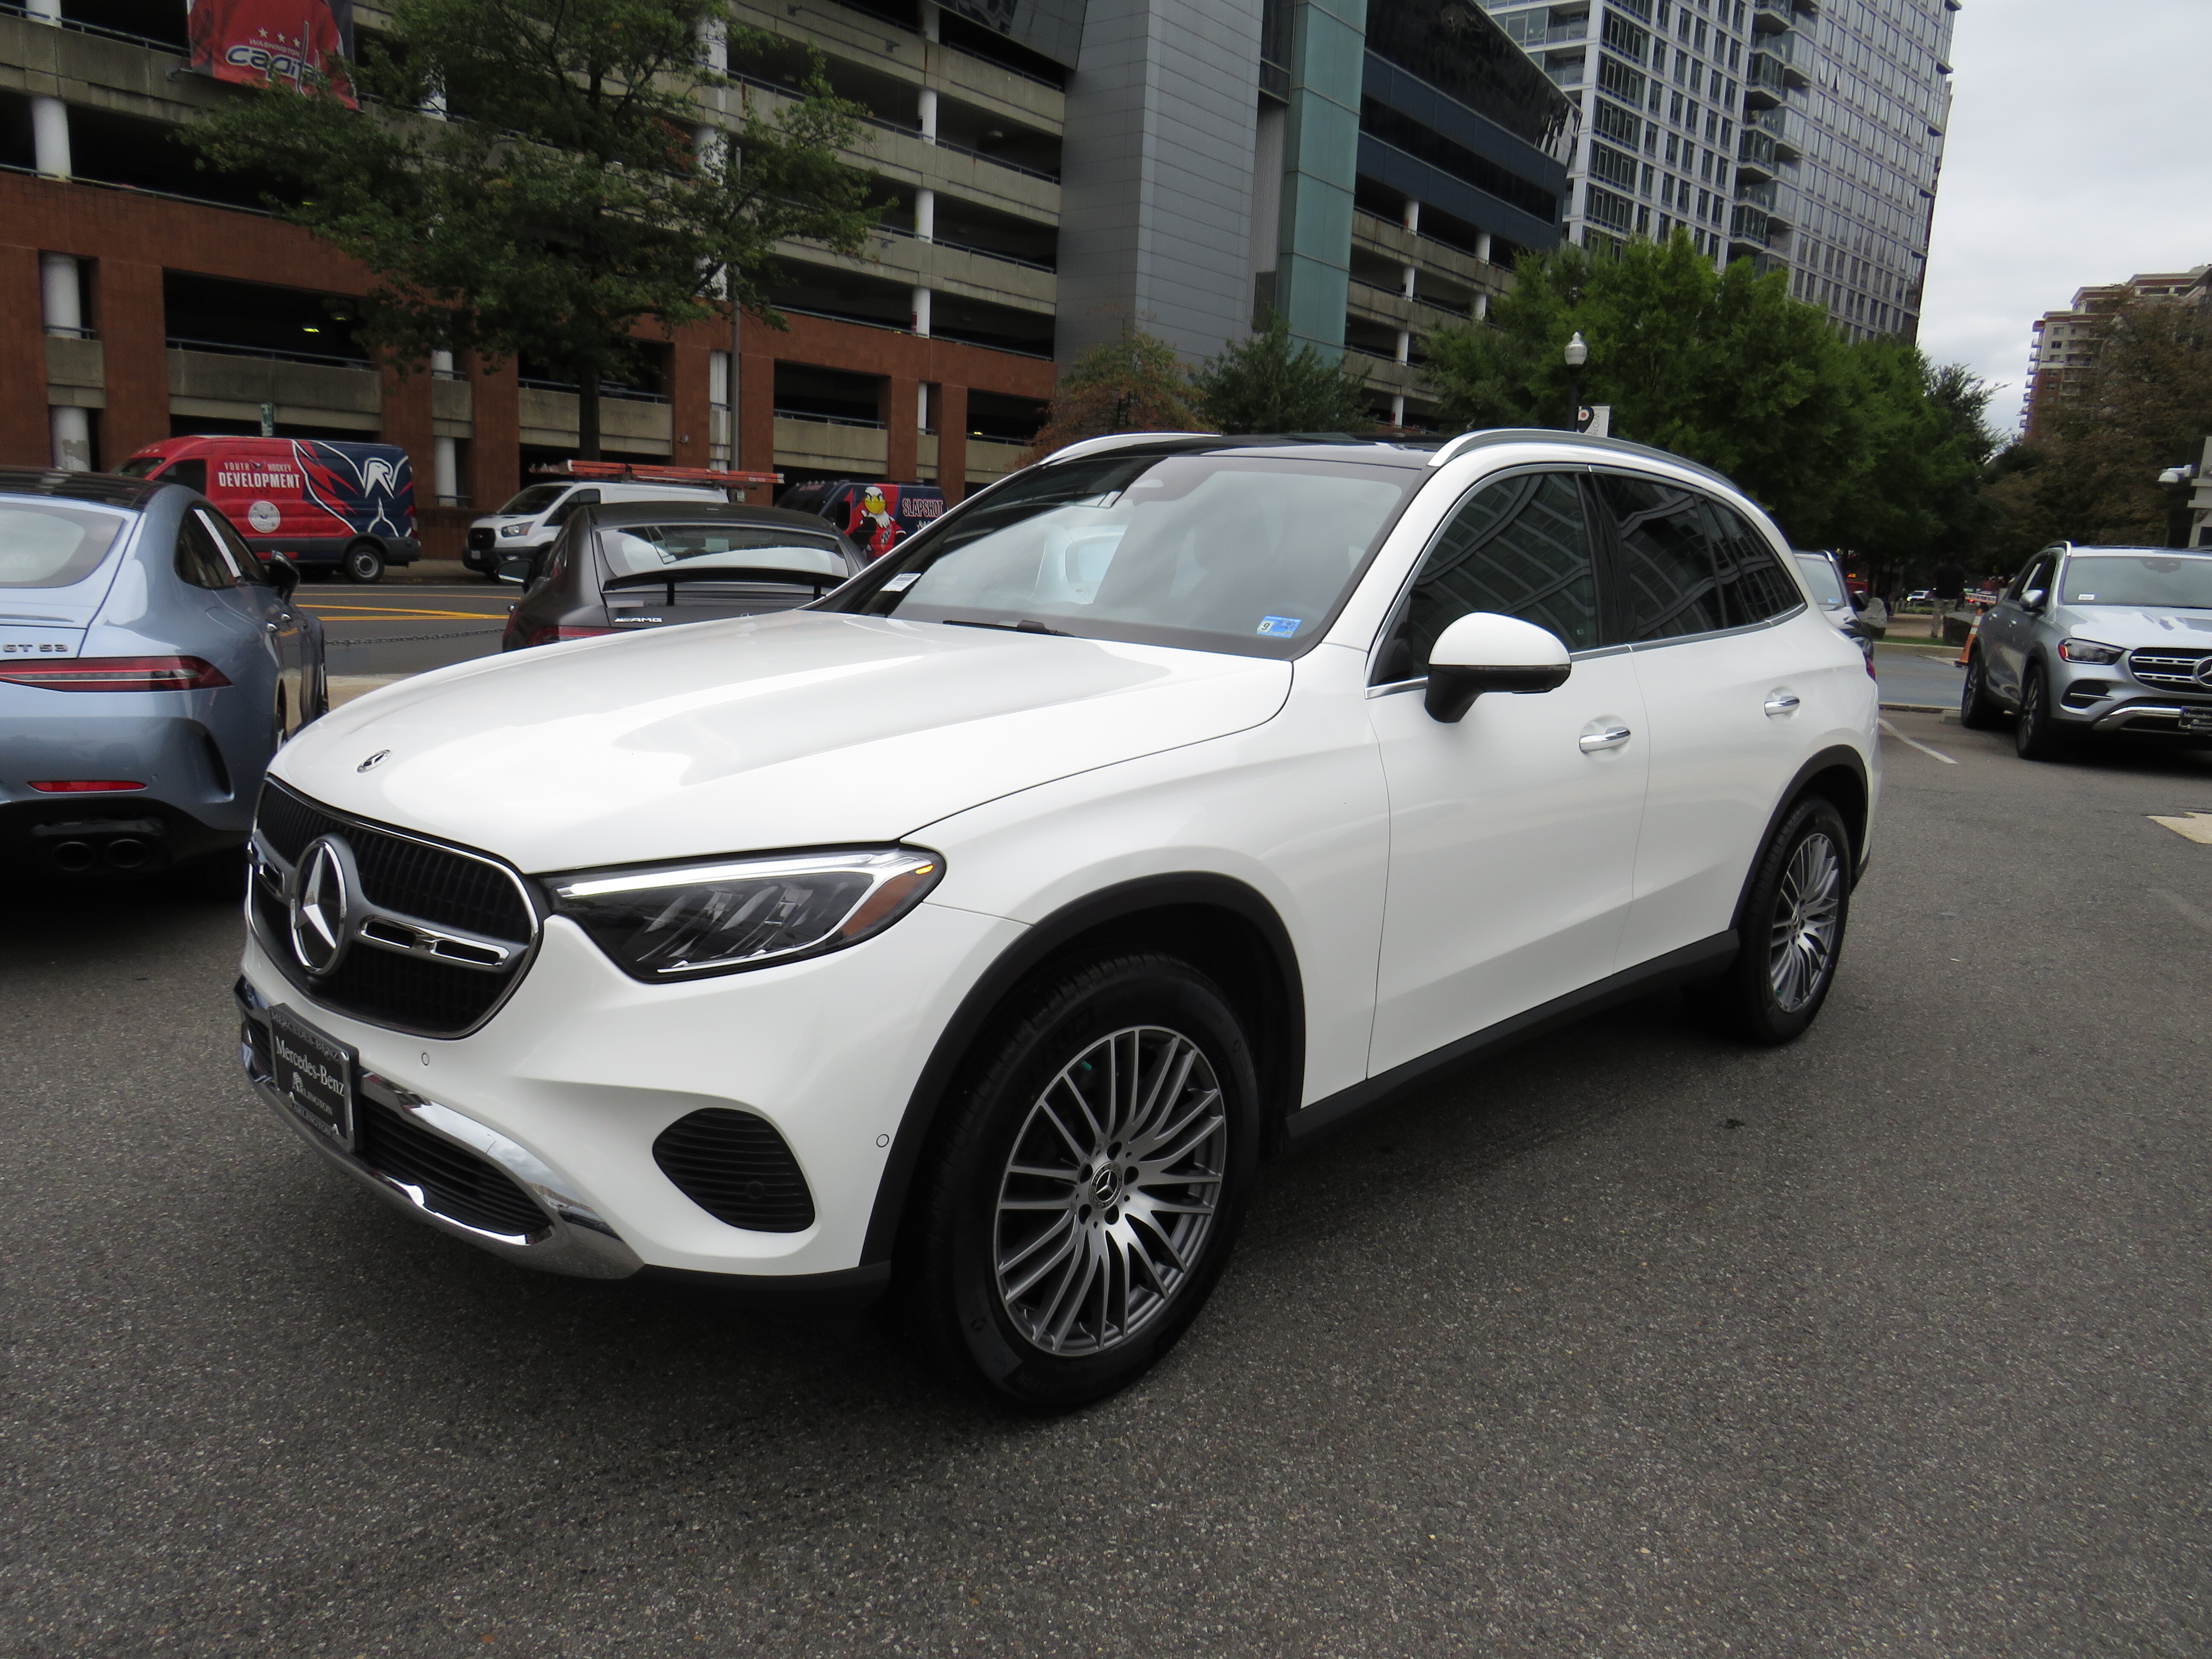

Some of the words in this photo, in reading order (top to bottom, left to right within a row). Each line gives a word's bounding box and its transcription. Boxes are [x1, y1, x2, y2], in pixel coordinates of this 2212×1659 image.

[224, 462, 250, 471] YOUTH
[268, 463, 292, 472] HOCKEY
[218, 472, 300, 488] DEVELOPMENT
[902, 498, 943, 518] SLAPSHOT
[3, 644, 33, 652] GT
[40, 644, 68, 652] 53
[275, 1036, 345, 1097] Mercedes-Benz
